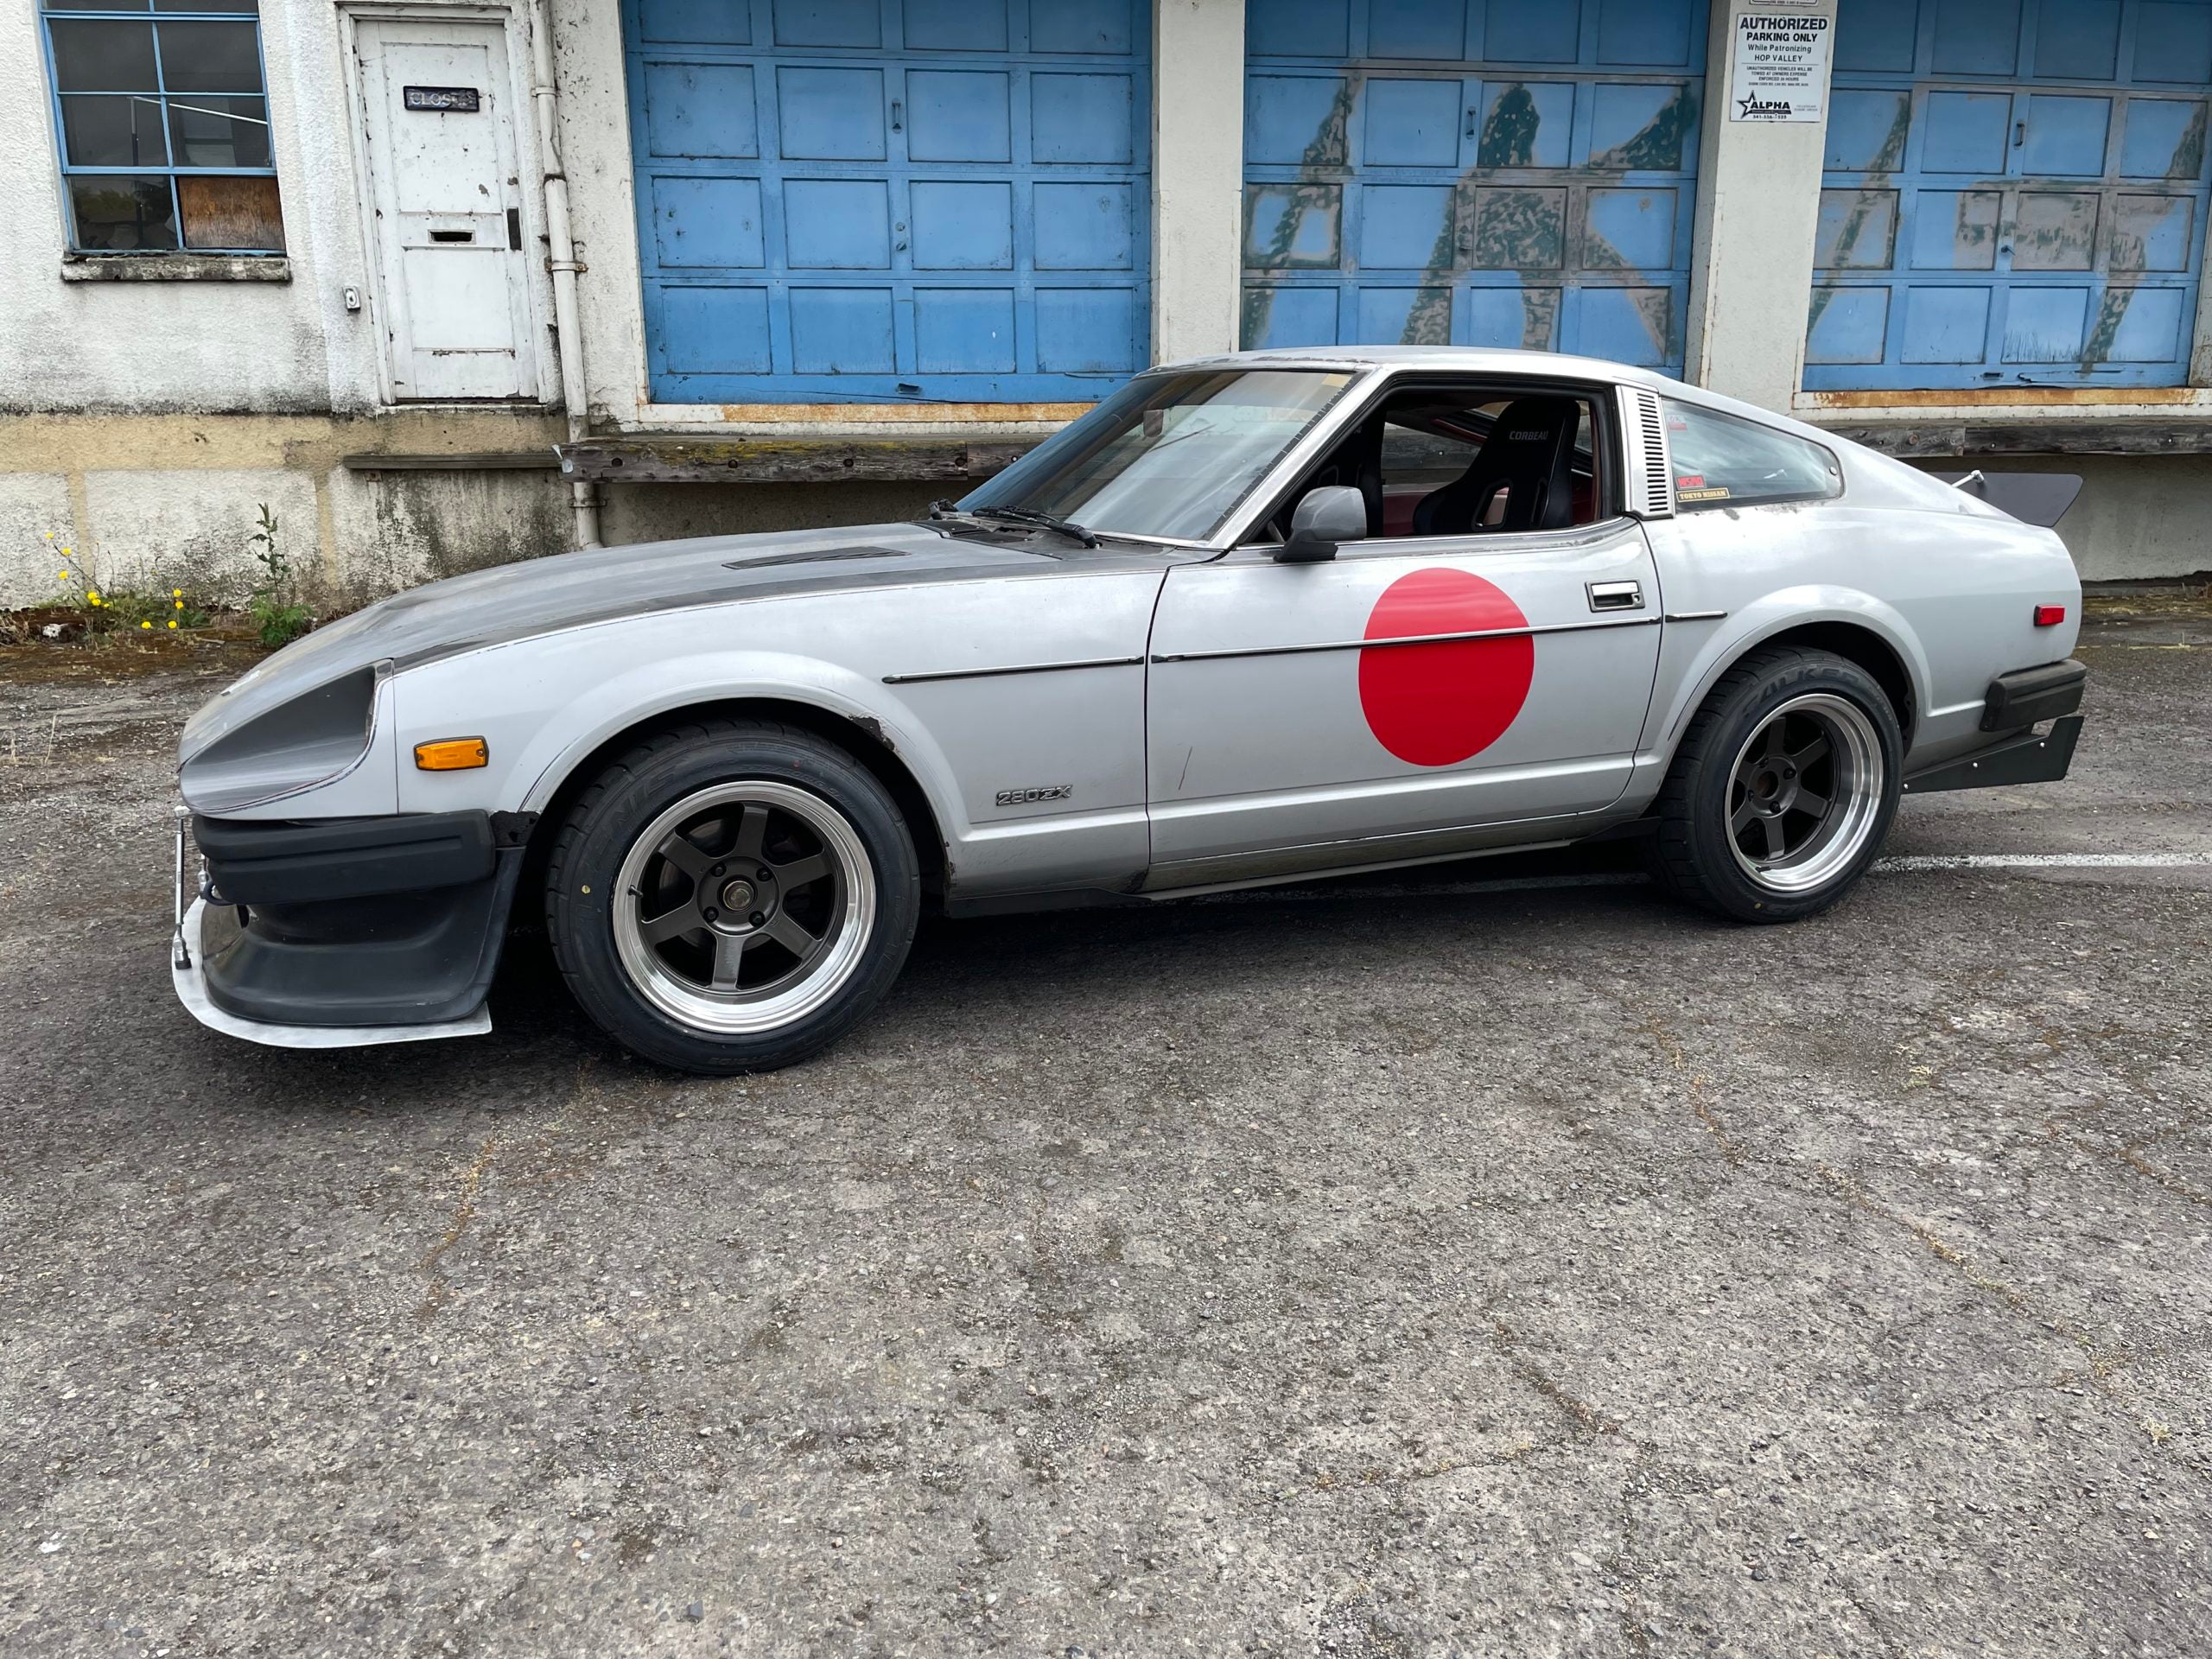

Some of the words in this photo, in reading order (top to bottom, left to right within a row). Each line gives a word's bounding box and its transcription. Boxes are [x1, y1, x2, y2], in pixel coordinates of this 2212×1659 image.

[1739, 16, 1827, 30] AUTHORIZED
[1746, 32, 1789, 41] PARKING
[1793, 34, 1818, 42] ONLY
[1769, 44, 1812, 54] Patronizing
[409, 92, 476, 107] CLOS
[1750, 101, 1790, 110] ALPHA
[1509, 429, 1549, 441] CORBEAU
[1702, 490, 1726, 499] NISSAN
[995, 784, 1073, 806] 280ZX
